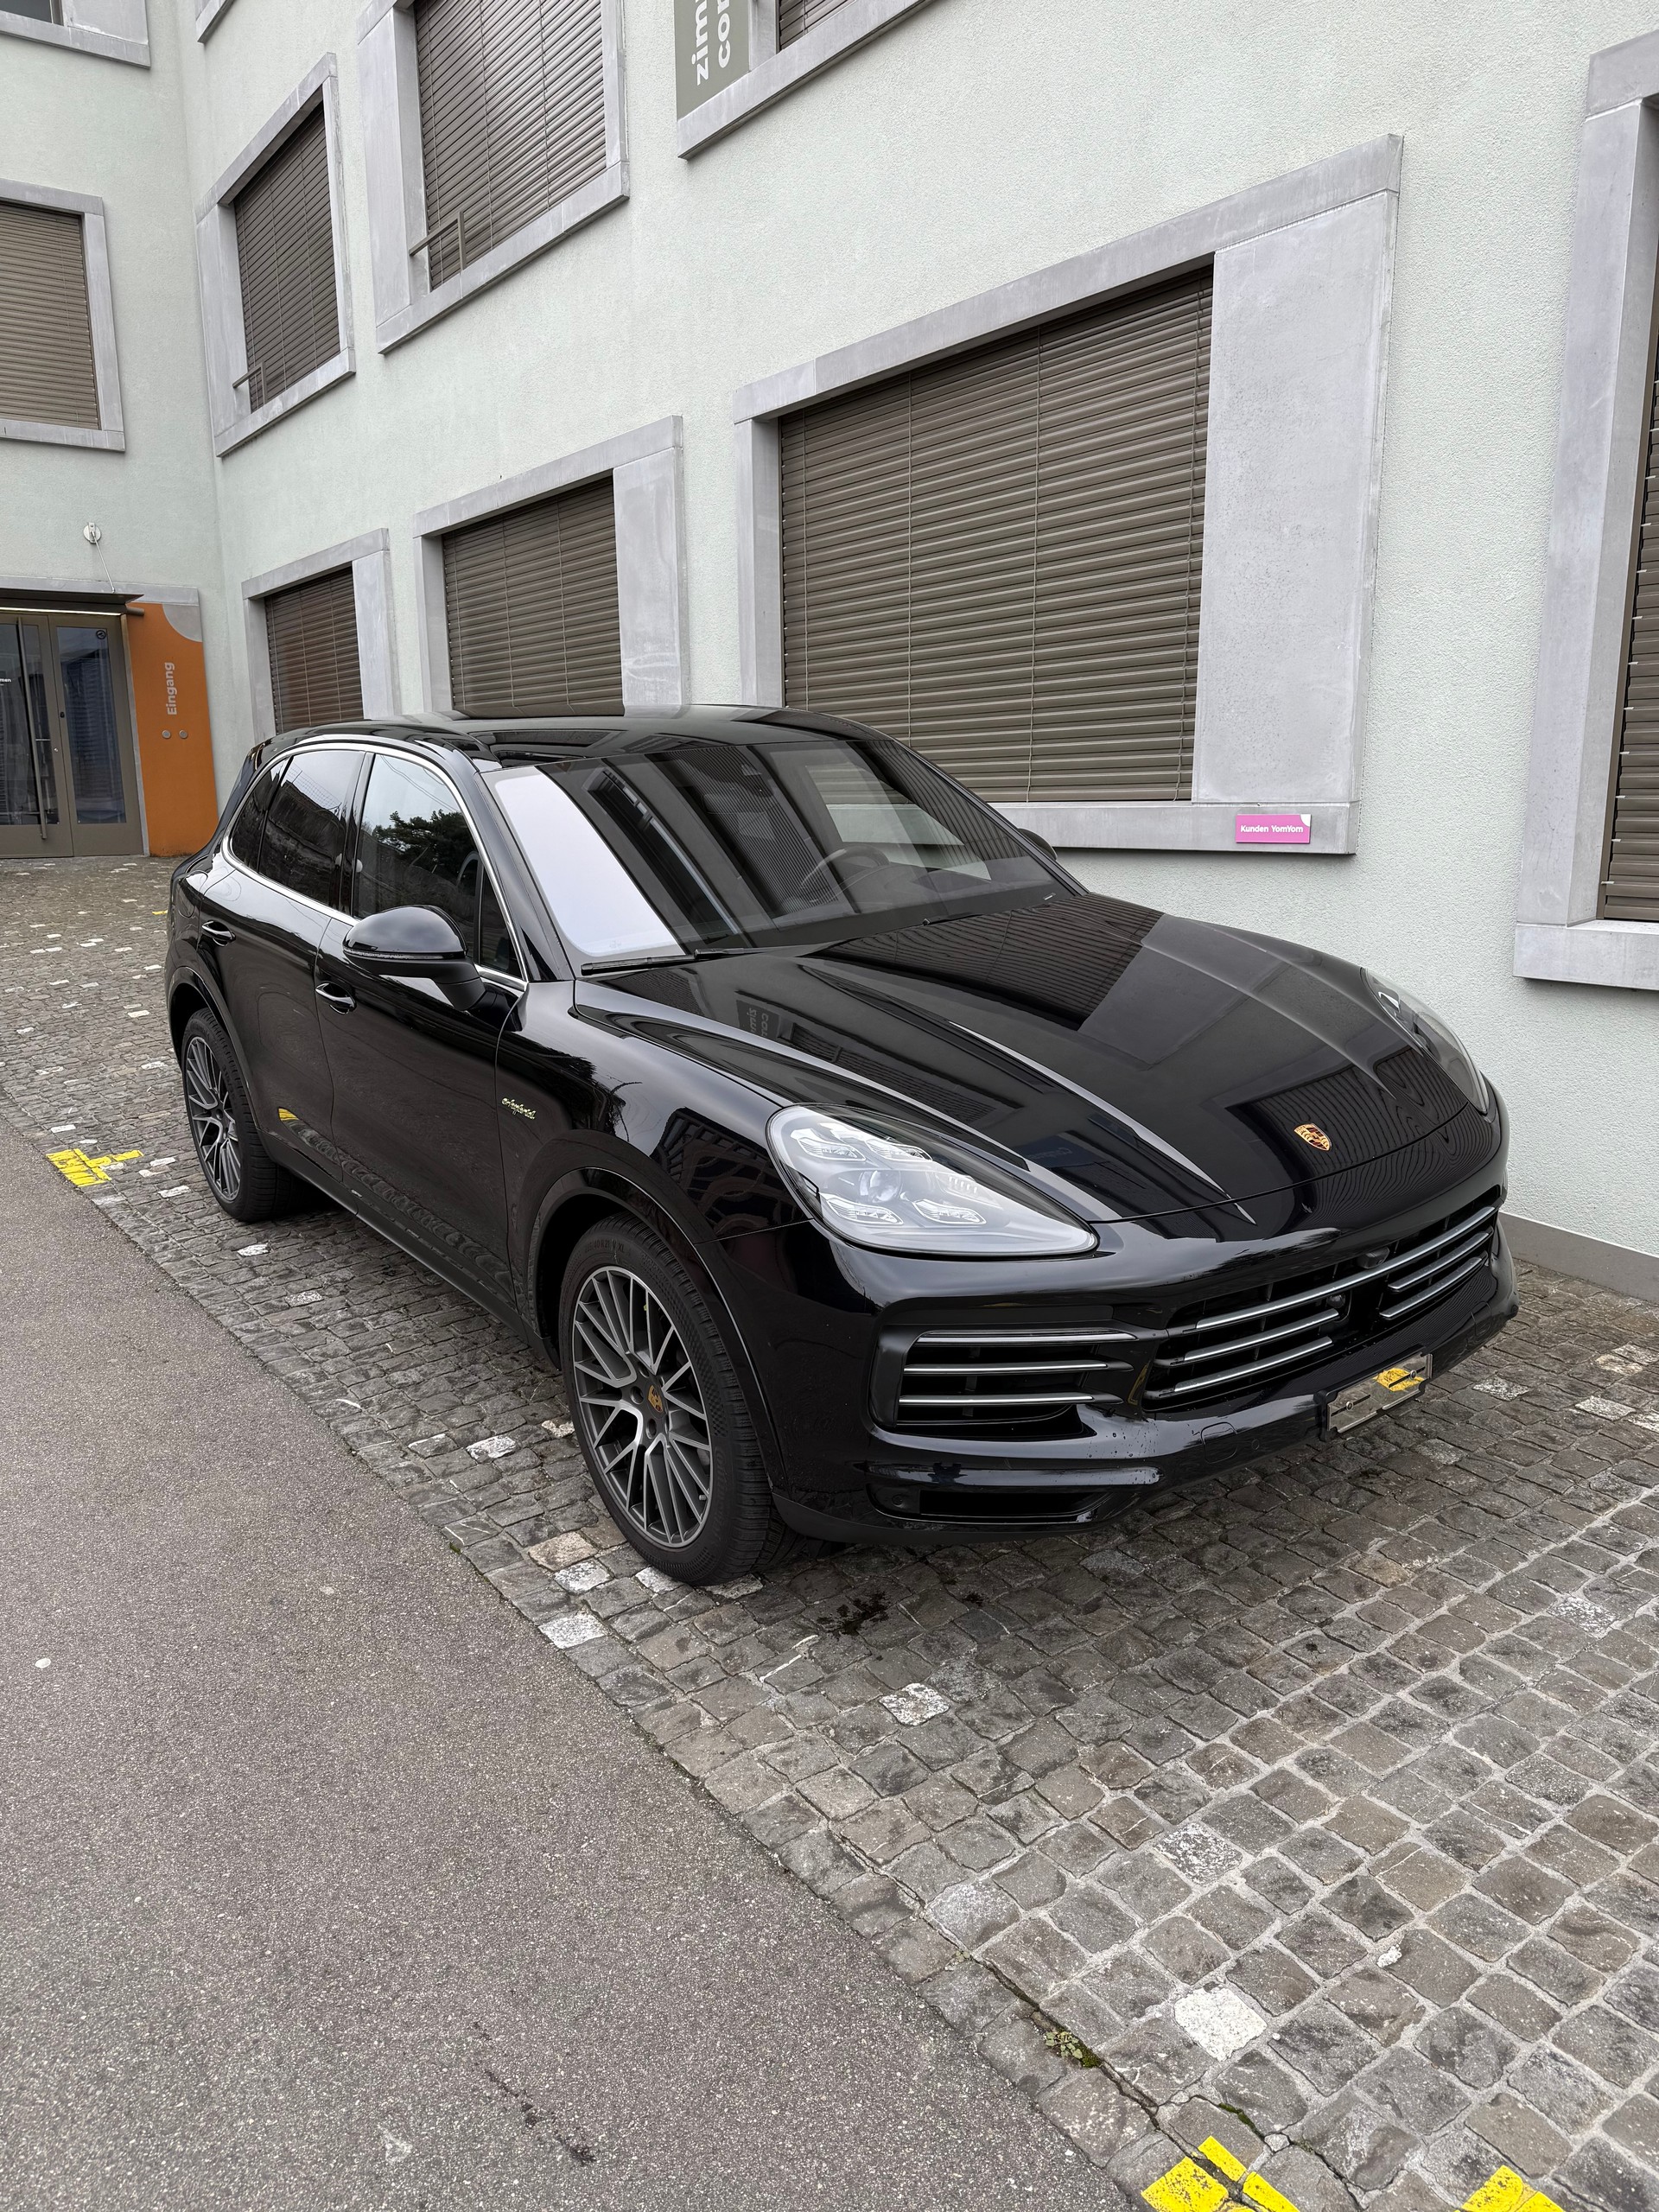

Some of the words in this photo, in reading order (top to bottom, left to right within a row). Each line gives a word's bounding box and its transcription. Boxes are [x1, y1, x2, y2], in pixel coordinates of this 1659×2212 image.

[691, 0, 709, 86] zim
[164, 662, 177, 715] Eingang
[1240, 824, 1269, 833] Kunden
[1271, 824, 1304, 833] YomYom
